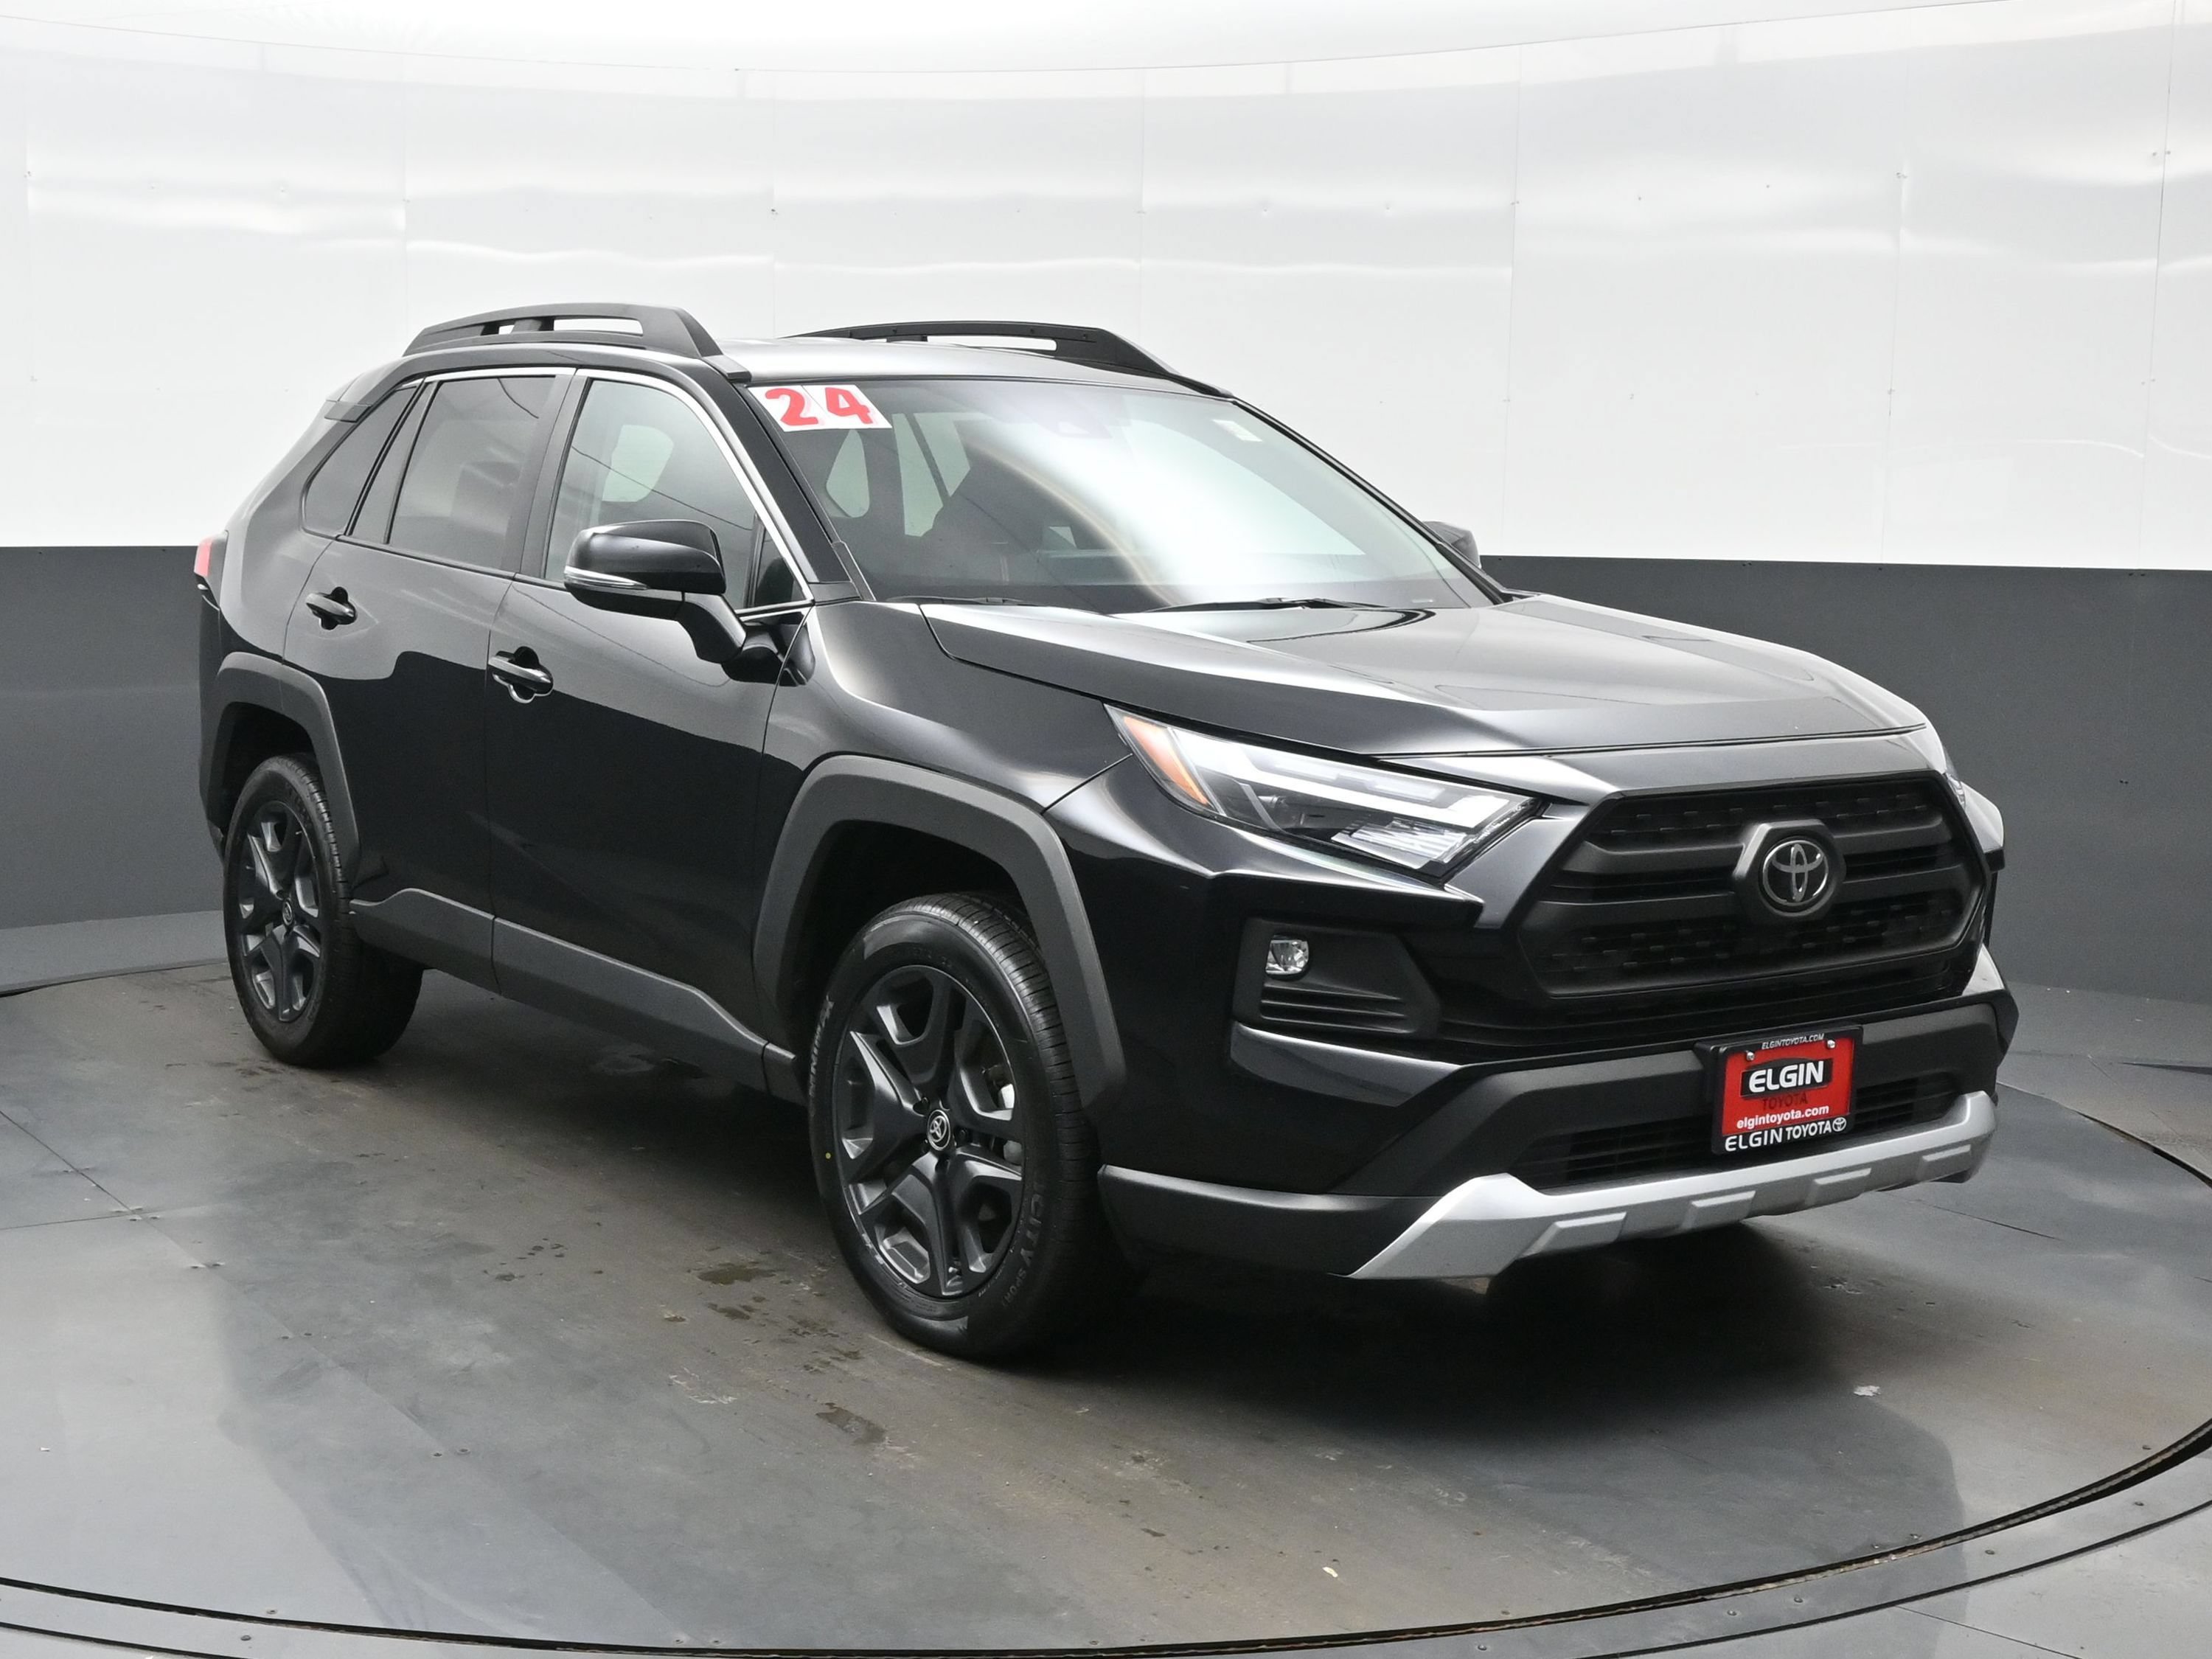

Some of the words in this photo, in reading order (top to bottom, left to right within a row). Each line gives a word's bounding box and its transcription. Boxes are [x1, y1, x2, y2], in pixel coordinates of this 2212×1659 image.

[765, 387, 873, 425] 24
[1761, 1033, 1824, 1050] ELGINTOYOTA.COM
[1749, 1060, 1824, 1093] ELGIN
[1762, 1093, 1808, 1110] TOYOTA
[1736, 1105, 1829, 1130] elgintoyota.com
[1725, 1127, 1783, 1152] ELGIN
[1786, 1120, 1832, 1140] TOYOTA
